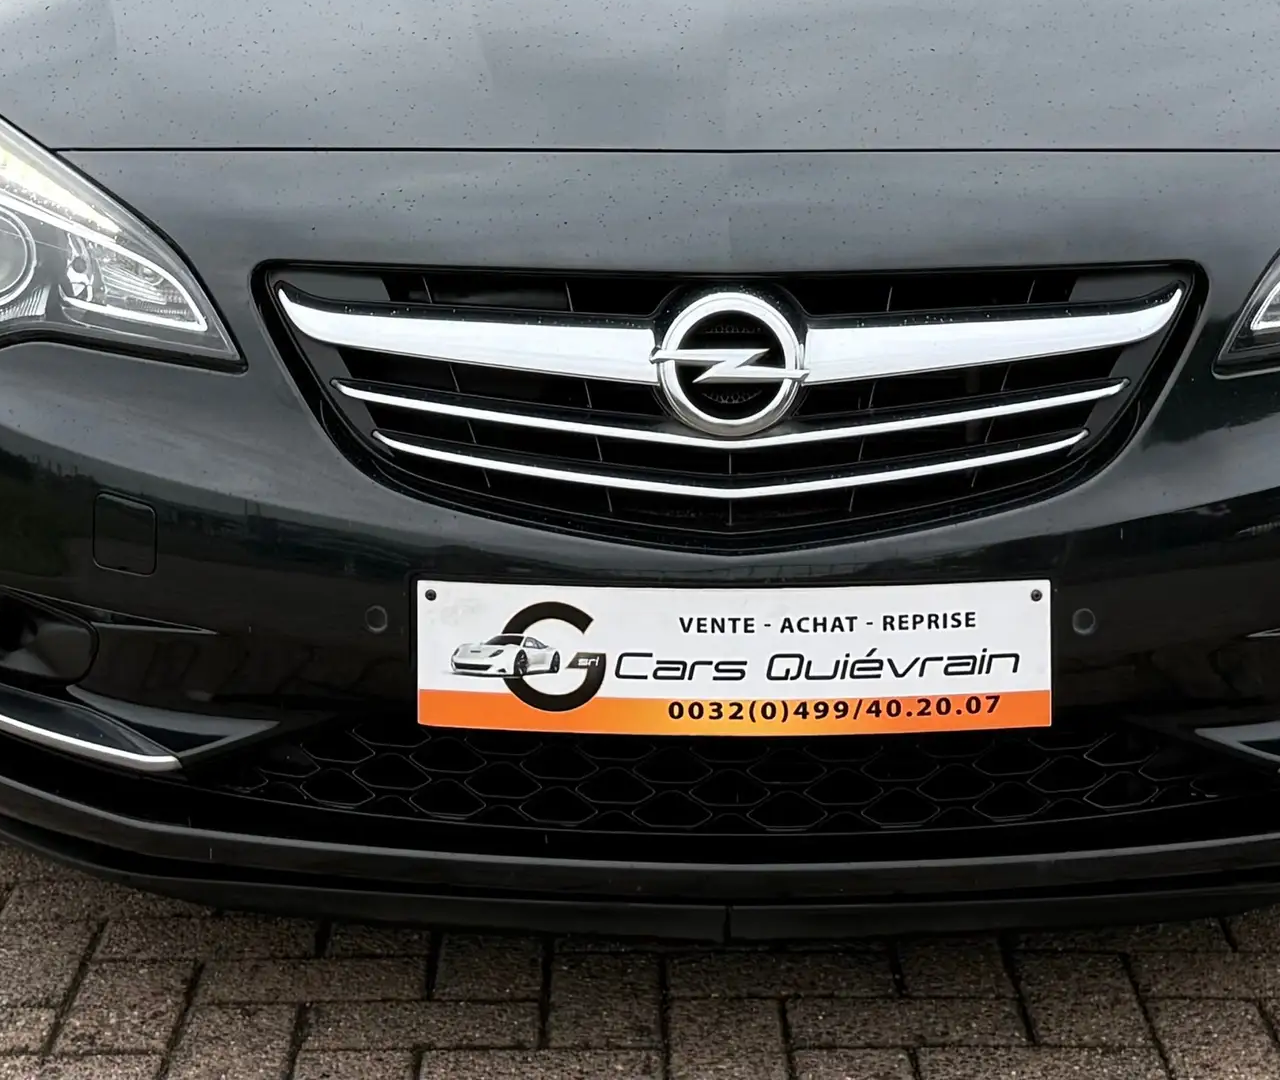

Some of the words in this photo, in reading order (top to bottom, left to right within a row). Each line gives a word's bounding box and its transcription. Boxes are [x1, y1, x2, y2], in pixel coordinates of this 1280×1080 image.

[679, 617, 755, 634] VENTE
[780, 616, 858, 634] ACHAT
[882, 611, 977, 632] REPRISE
[614, 652, 748, 681] Cars
[766, 648, 1020, 681] Quiévrain
[668, 695, 1001, 724] 0032(0)499/40.20.07
